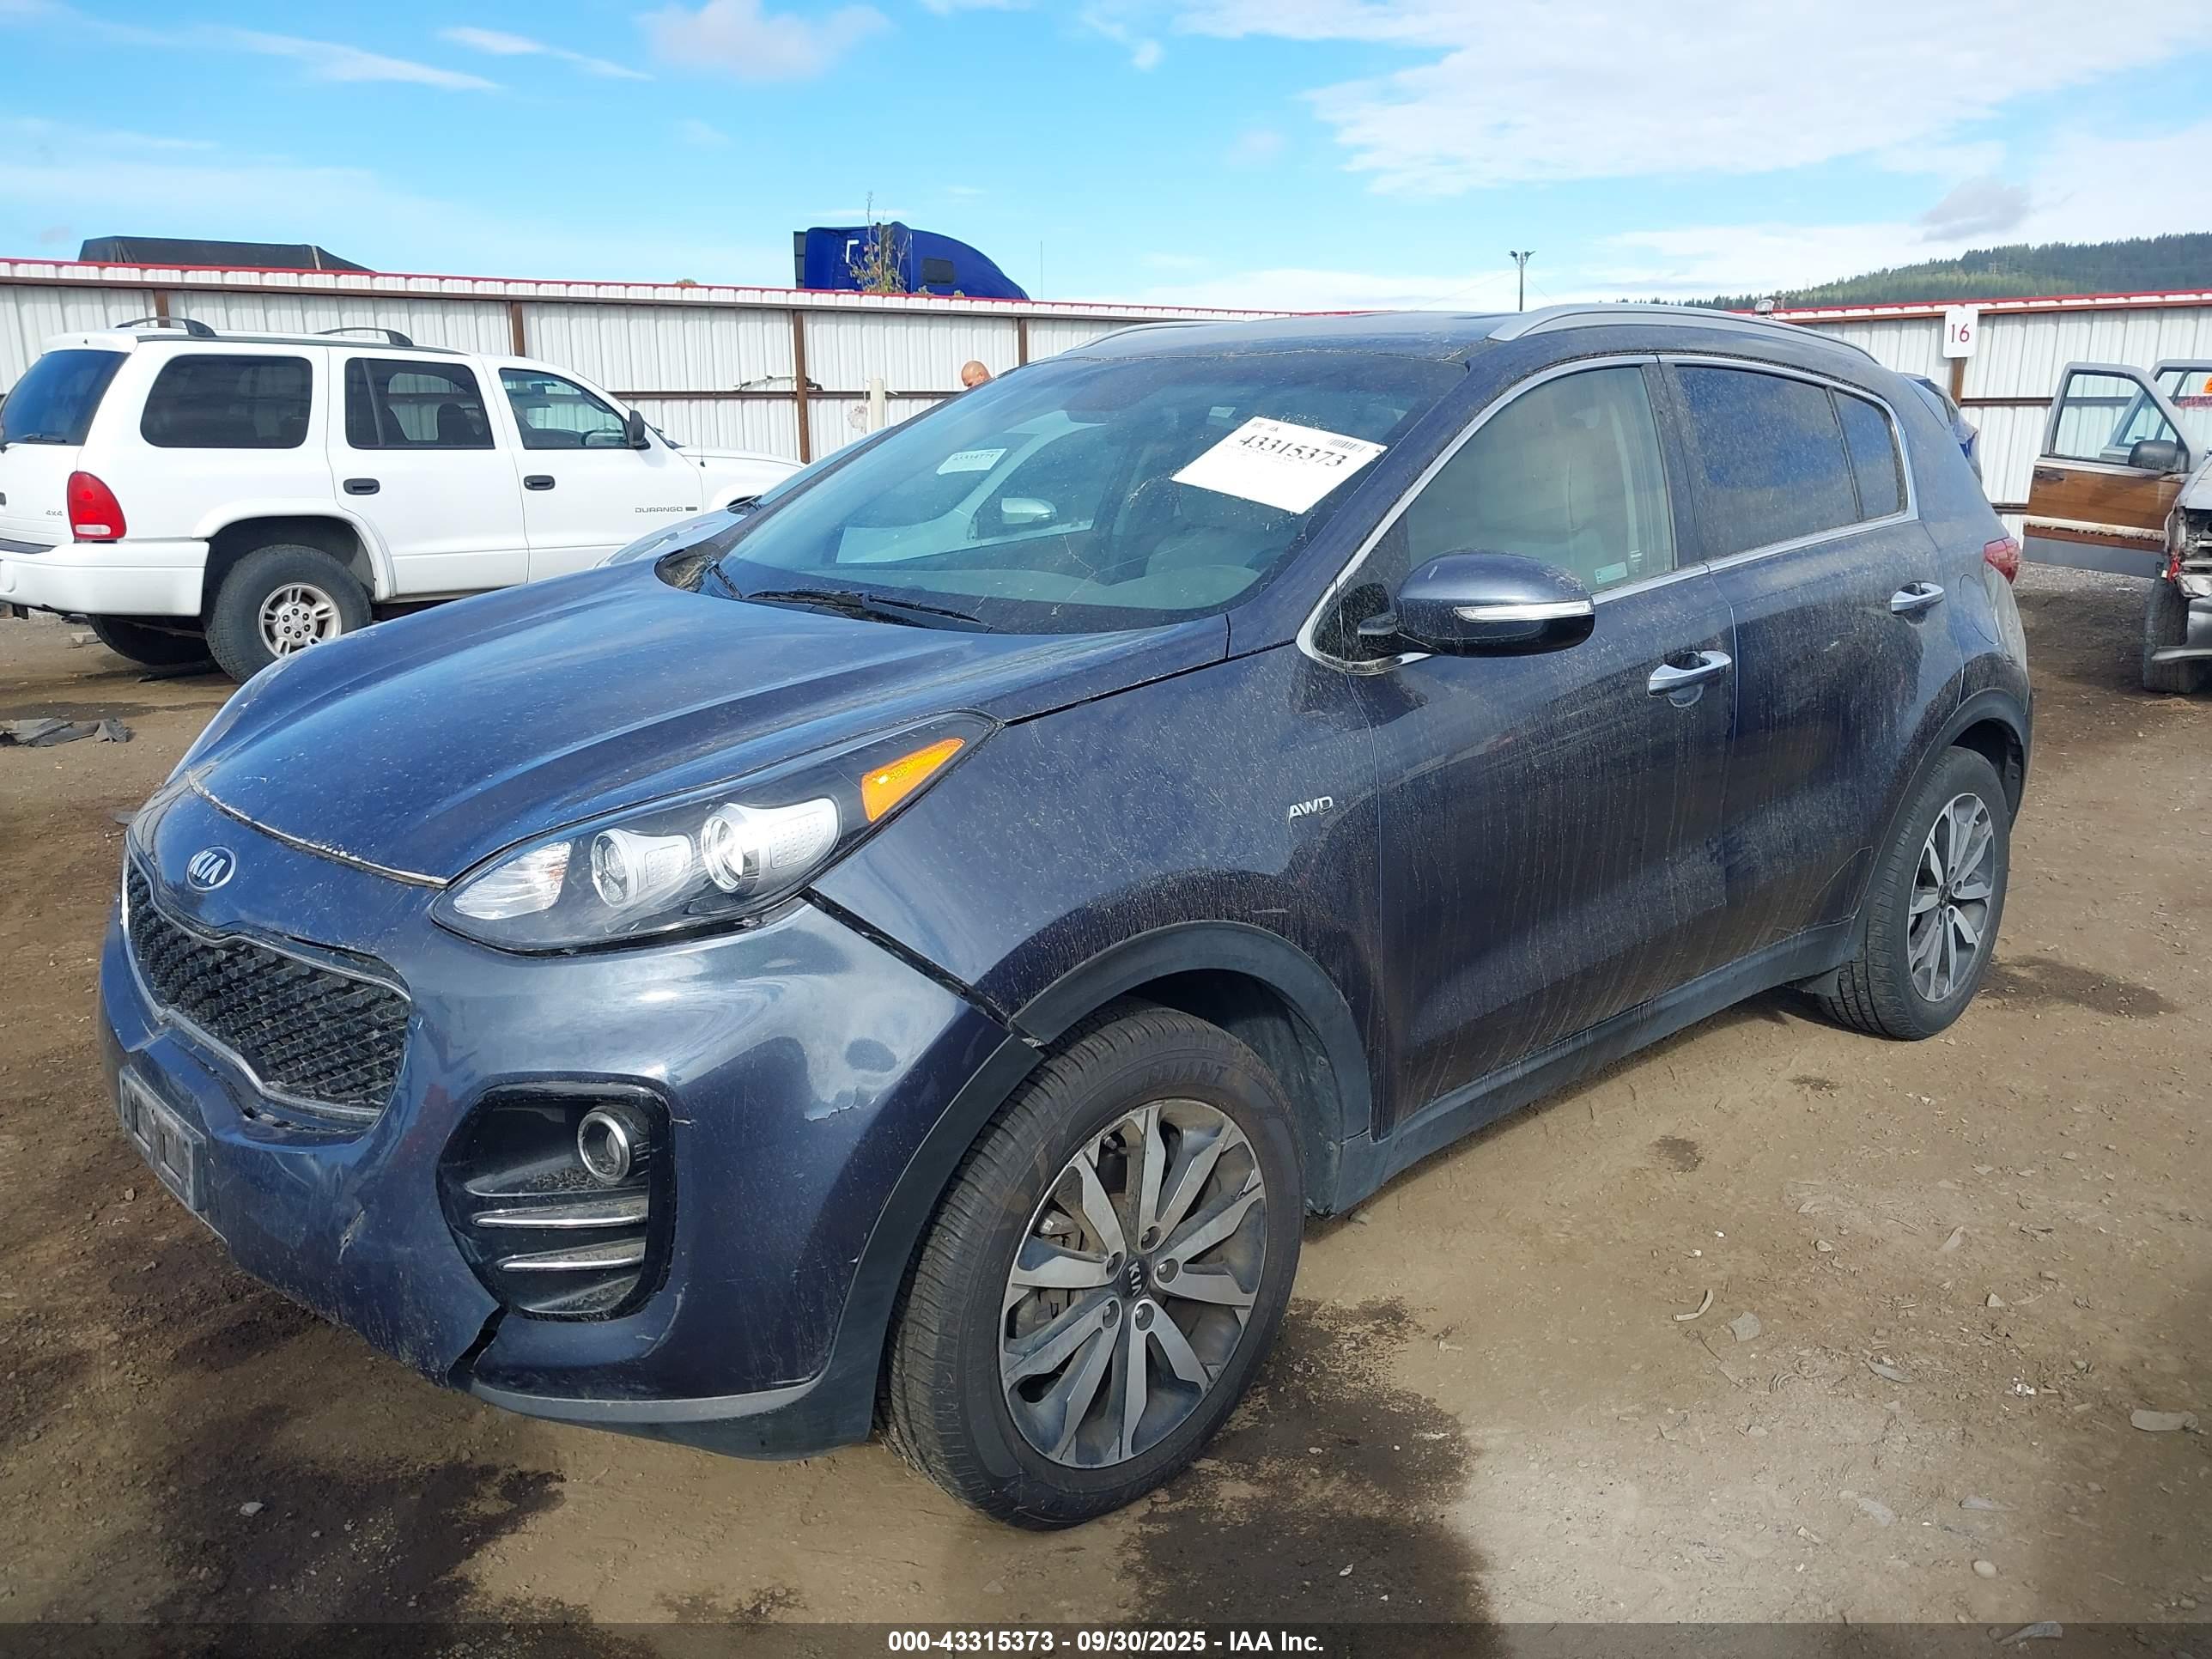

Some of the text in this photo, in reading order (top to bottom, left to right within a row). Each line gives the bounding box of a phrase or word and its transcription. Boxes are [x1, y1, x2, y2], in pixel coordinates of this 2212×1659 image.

[1950, 322, 1970, 343] 16
[1239, 434, 1347, 467] 43315373
[1287, 795, 1334, 818] AWD
[1128, 1260, 1143, 1297] KIA
